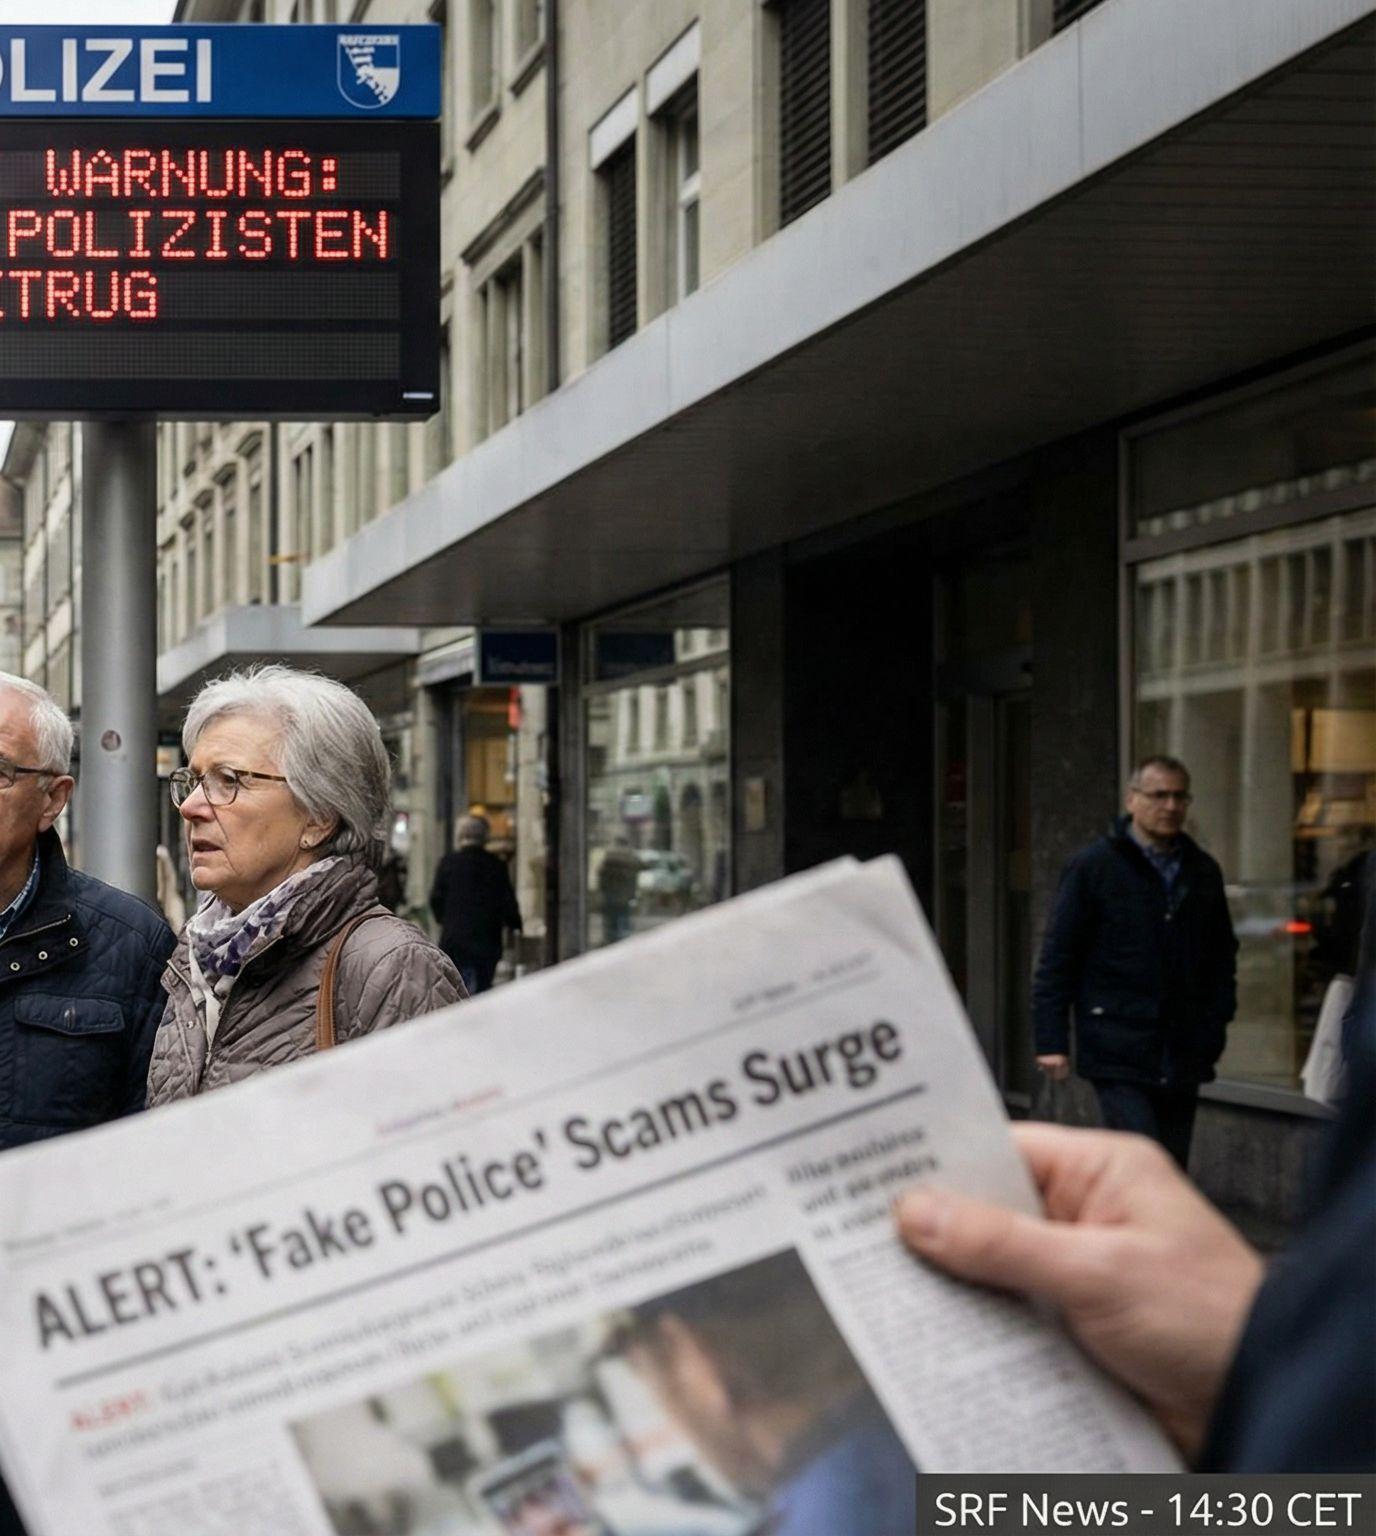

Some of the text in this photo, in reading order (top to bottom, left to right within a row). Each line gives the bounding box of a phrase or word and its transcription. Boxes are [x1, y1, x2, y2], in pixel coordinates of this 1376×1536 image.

[46, 148, 337, 198] WARNUNG:
[7, 209, 388, 259] POLIZISTEN
[33, 1247, 227, 1350] ALERT:
[562, 1079, 739, 1171] Scams
[741, 1018, 902, 1107] Surge
